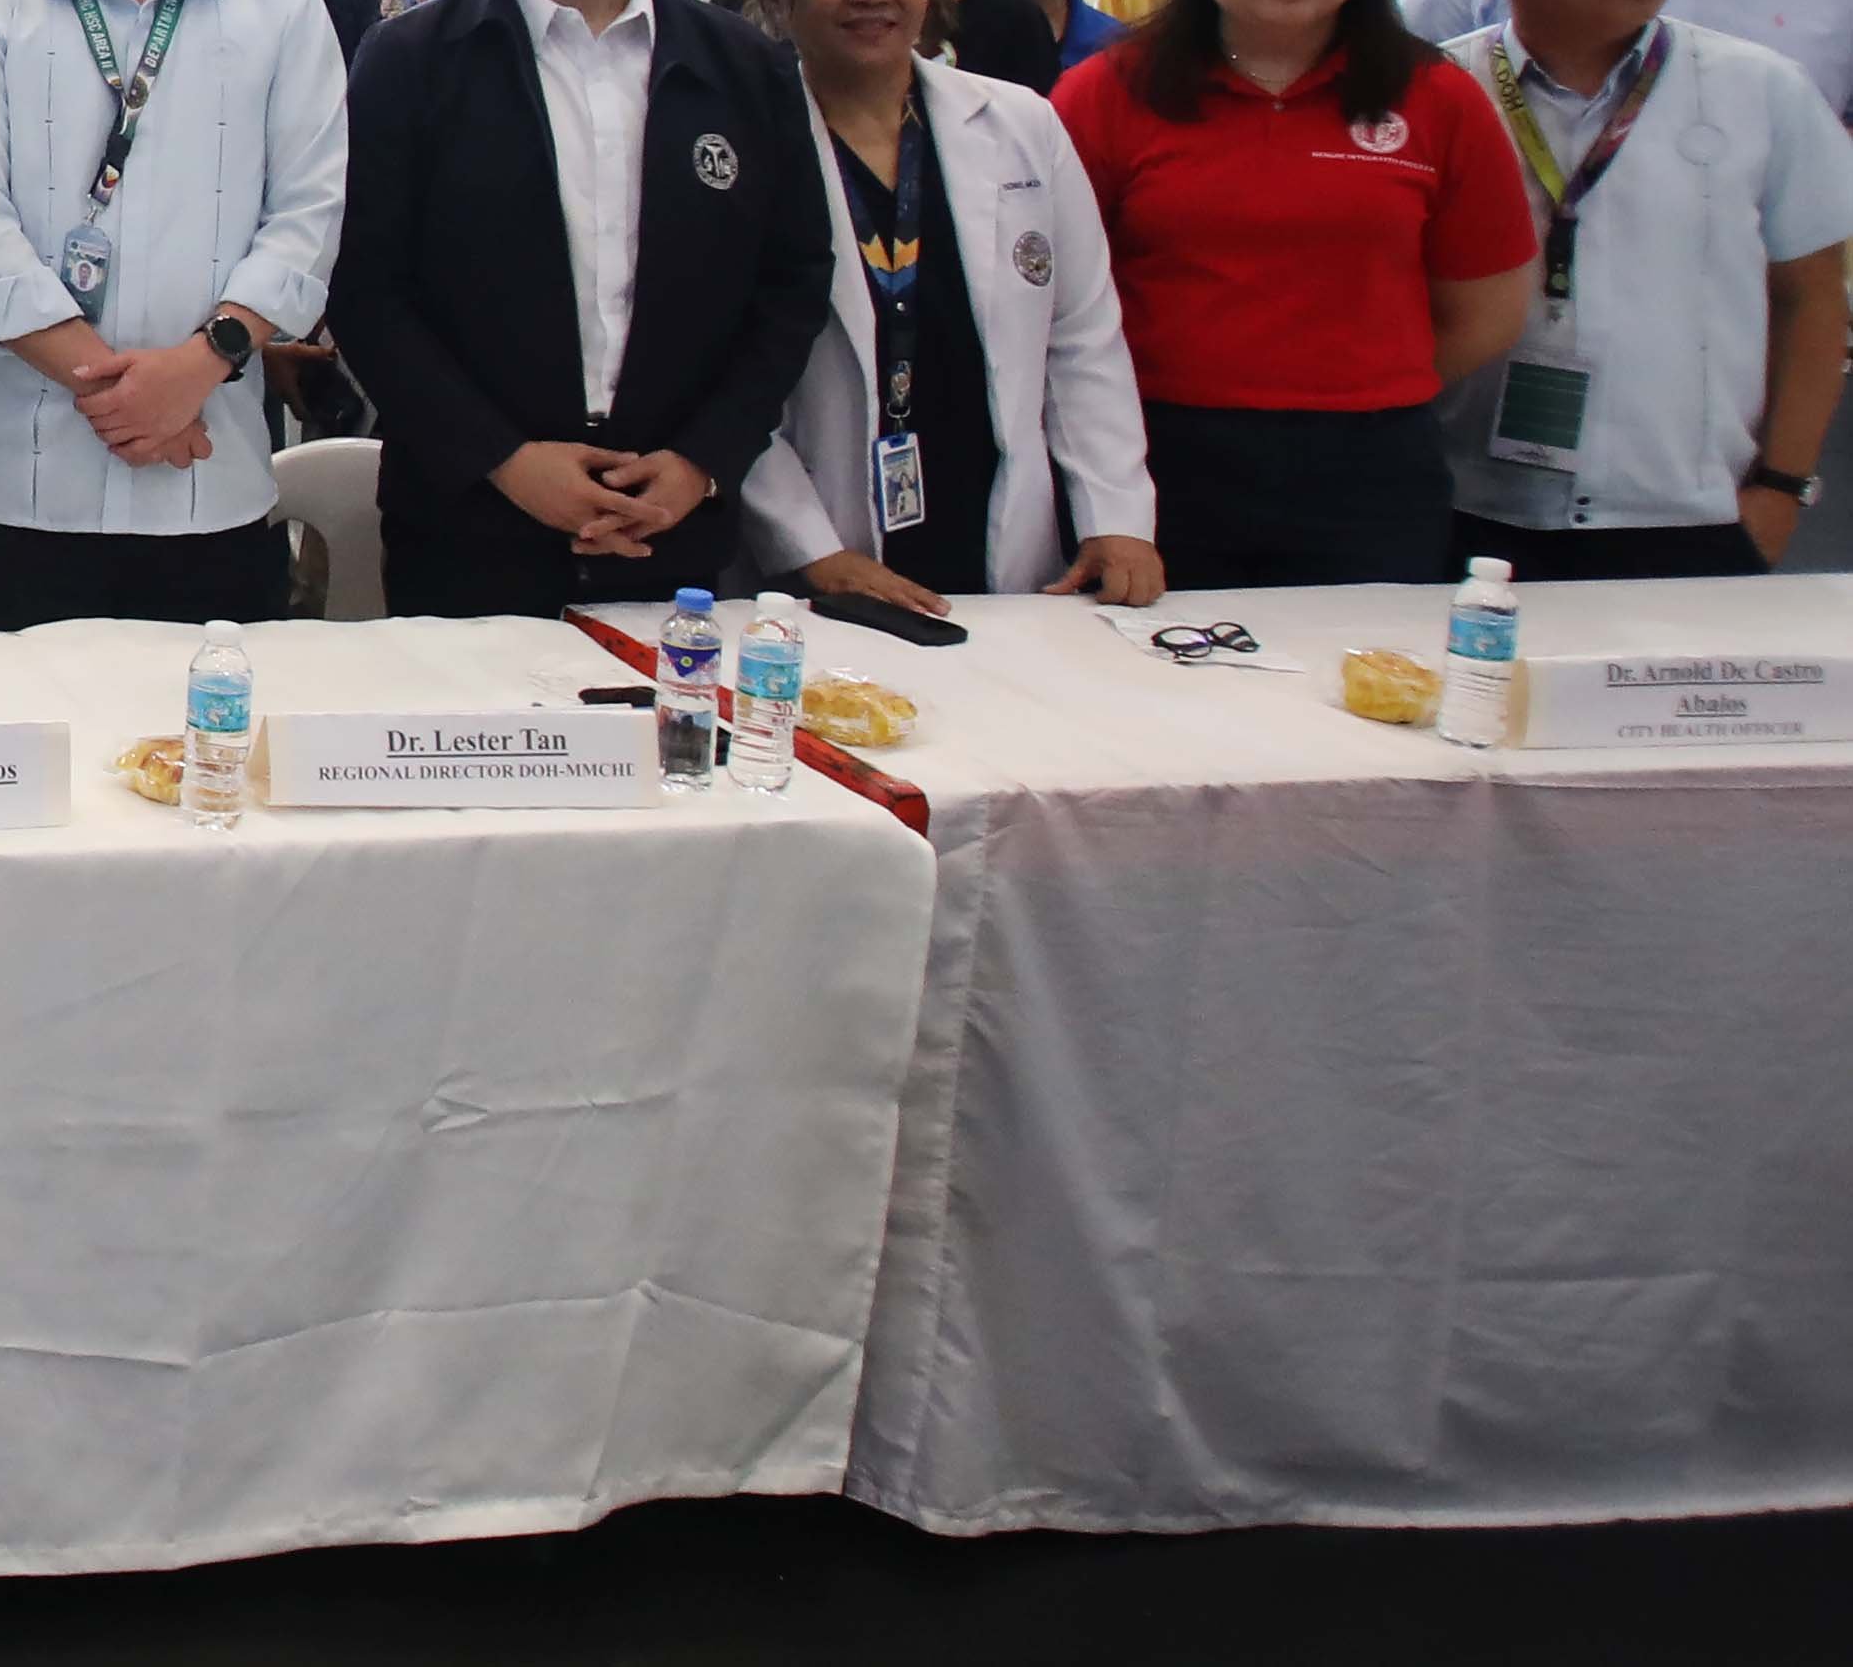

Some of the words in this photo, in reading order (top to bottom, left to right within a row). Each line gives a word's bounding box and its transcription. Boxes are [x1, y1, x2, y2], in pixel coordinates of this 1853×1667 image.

[91, 33, 112, 59] AREA
[386, 730, 425, 752] Dr.
[434, 730, 513, 752] Lester
[519, 729, 567, 751] Tan
[319, 766, 417, 780] REGIONAL
[420, 764, 514, 779] DIRECTOR
